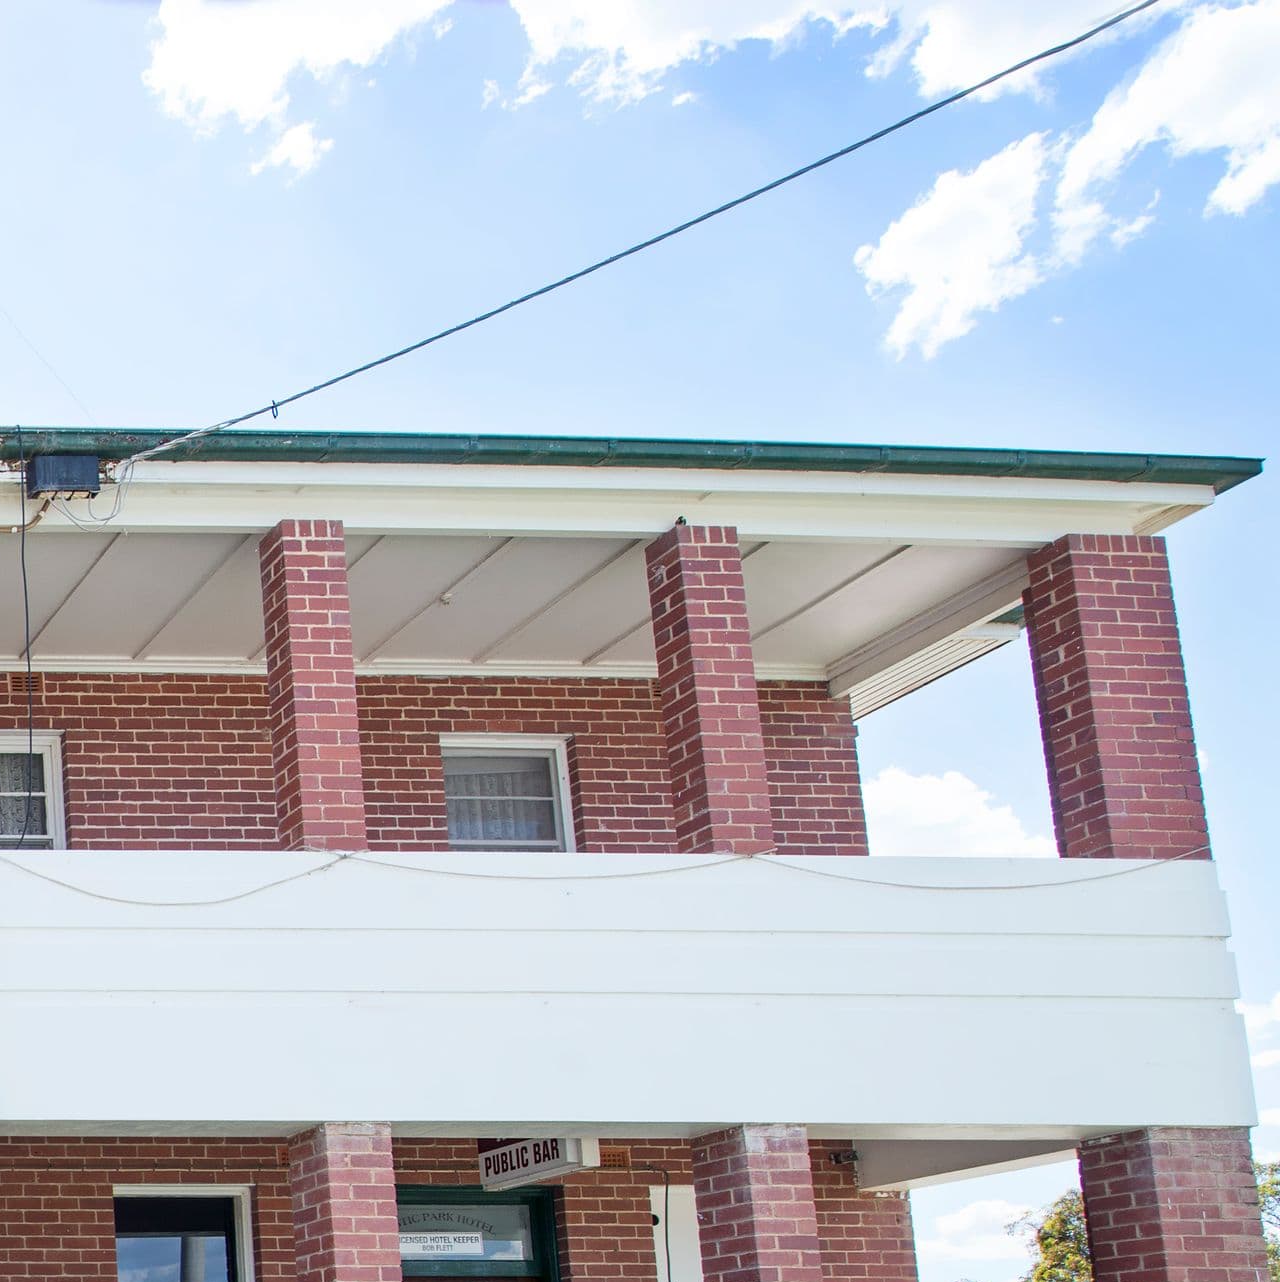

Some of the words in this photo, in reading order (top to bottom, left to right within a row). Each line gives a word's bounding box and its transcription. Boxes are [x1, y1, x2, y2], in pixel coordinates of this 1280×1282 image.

[484, 1146, 529, 1177] PUBLIC
[533, 1138, 560, 1165] BAR
[422, 1212, 453, 1222] PARK
[457, 1215, 496, 1236] HOTEL
[430, 1236, 452, 1244] HOTEL
[454, 1236, 480, 1244] KEEPER
